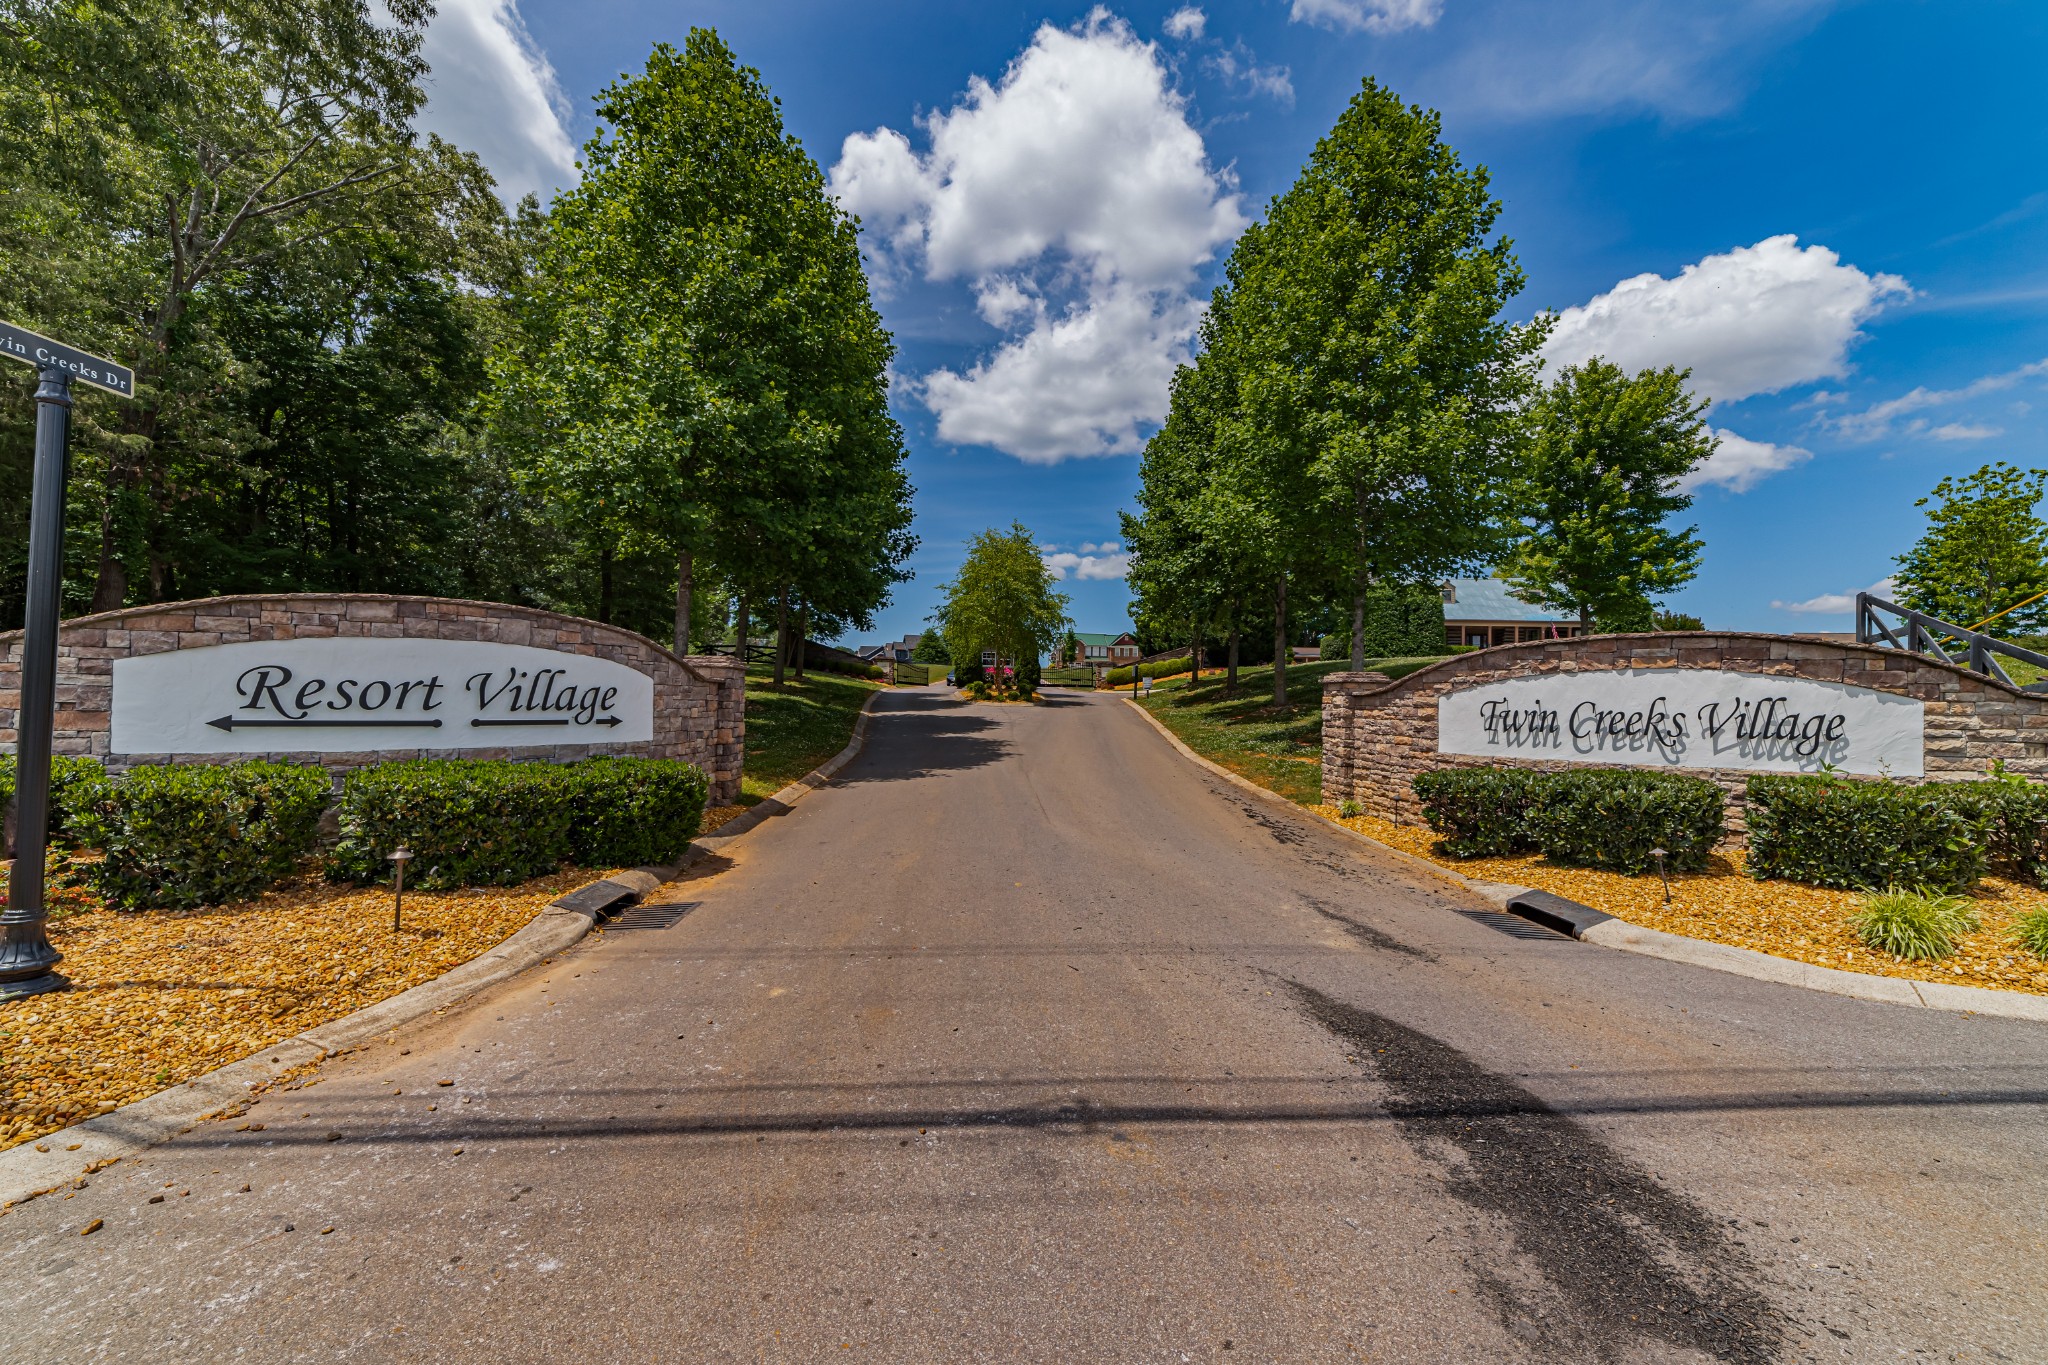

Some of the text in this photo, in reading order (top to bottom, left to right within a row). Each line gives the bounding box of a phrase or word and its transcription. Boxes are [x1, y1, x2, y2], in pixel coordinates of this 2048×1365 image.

[35, 347, 98, 379] Creeks
[105, 371, 127, 390] Dr
[236, 665, 618, 726] Resort Village
[1480, 696, 1846, 756] Twin Creeks Village
